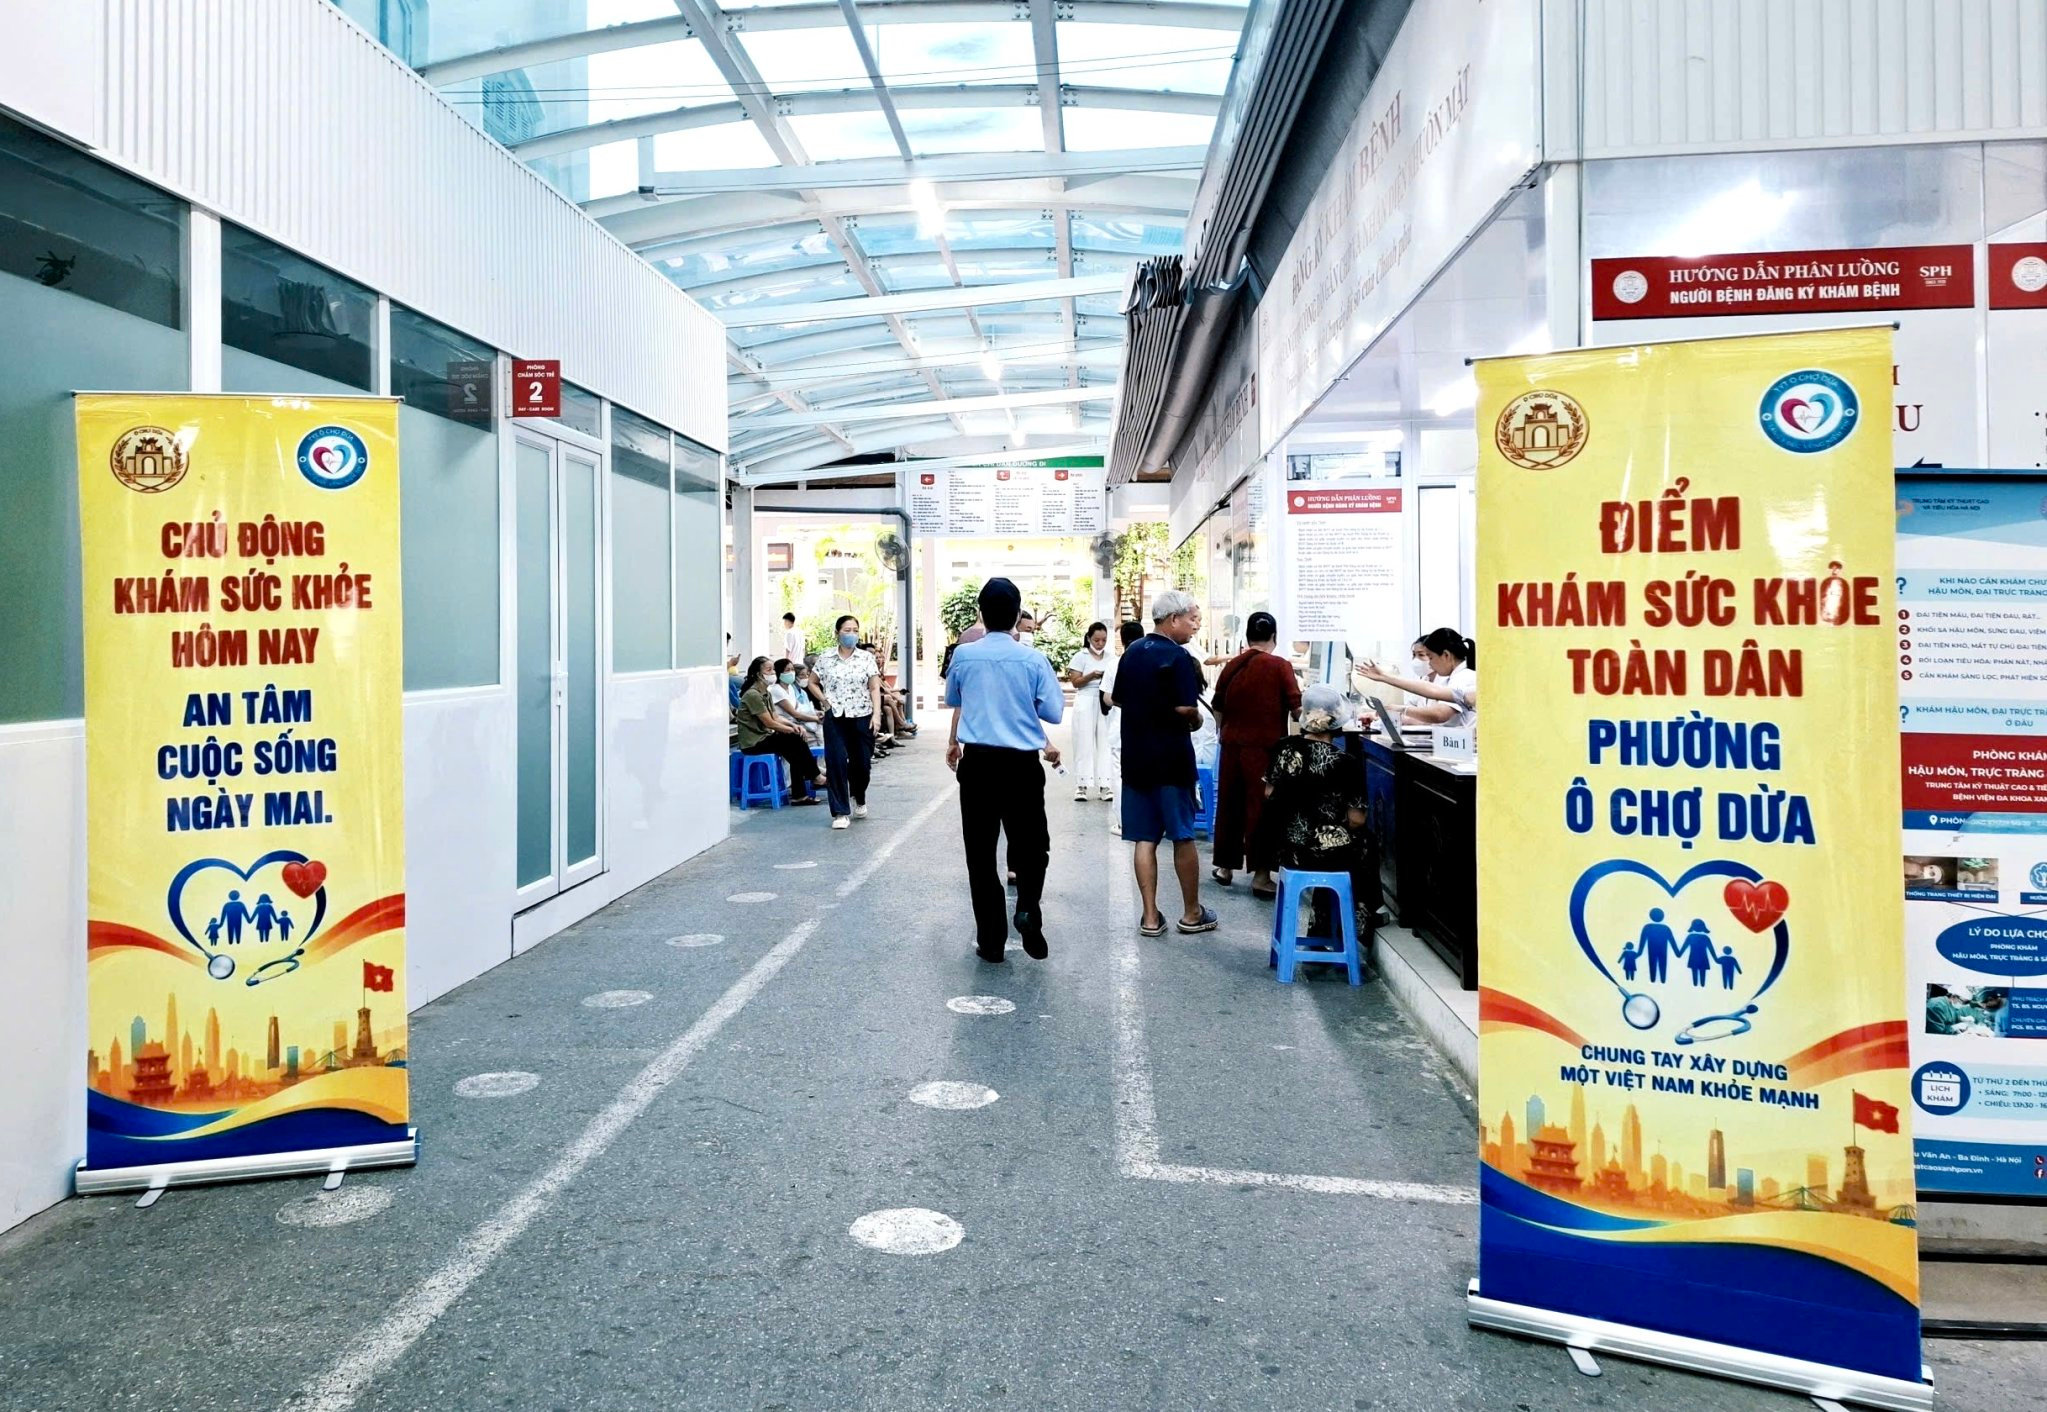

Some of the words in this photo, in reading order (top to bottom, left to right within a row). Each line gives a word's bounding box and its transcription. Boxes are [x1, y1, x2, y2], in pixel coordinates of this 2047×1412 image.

[1359, 89, 1402, 191] BỆNH
[1669, 265, 1739, 283] HƯỚNG
[1742, 260, 1780, 280] DẪN
[1784, 261, 1834, 279] PHÂN
[1838, 258, 1900, 277] LUỒNG
[1919, 265, 1952, 277] SPH
[1670, 287, 1712, 304] NGƯỜI
[1716, 286, 1752, 305] BỆNH
[1756, 285, 1794, 301] ĐĂNG
[1798, 283, 1815, 299] KÝ
[1819, 282, 1859, 299] KHÁM
[1863, 281, 1900, 300] BỆNH
[529, 381, 543, 401] 2
[1600, 477, 1741, 553] ĐIỂM
[161, 510, 227, 558] CHỦ
[237, 514, 325, 565] ĐỘNG
[114, 568, 209, 614] KHÁM
[220, 568, 281, 611] SỨC
[292, 562, 372, 610] KHỎE
[1950, 588, 1974, 596] MÔN,
[1958, 577, 1978, 585] NÀO
[2000, 577, 2026, 586] KHÁM
[1498, 572, 1626, 627] KHÁM
[1644, 570, 1737, 627] SỨC
[1753, 562, 1880, 626] KHỎE
[171, 623, 247, 668] HÔM
[258, 627, 319, 665] NAY
[1567, 640, 1687, 696] TOÀN
[1704, 639, 1803, 697] DÂN
[182, 693, 231, 727] AN
[242, 684, 312, 724] TÂM
[1945, 706, 1964, 714] HẬU
[1966, 706, 1990, 715] MÔN,
[2010, 708, 2032, 716] TRỰC
[2014, 718, 2034, 727] ĐÂU
[1443, 736, 1459, 748] Bàn
[1462, 738, 1466, 750] 1
[1588, 710, 1781, 771] PHƯỜNG
[157, 735, 243, 785] CUỘC
[254, 729, 337, 774] SỐNG
[1972, 749, 2016, 760] PHÒNG
[1908, 764, 1934, 778] HẬU
[1937, 765, 1968, 778] MÔN,
[1970, 766, 2002, 779] TRỰC
[2005, 766, 2044, 778] TRÀNG
[1952, 793, 1975, 802] BỆNH
[1976, 794, 1995, 802] VIỆN
[1972, 782, 1982, 790] KỸ
[1984, 782, 2009, 791] THUẬT
[166, 787, 253, 831] NGÀY
[264, 790, 333, 827] MAI.
[1565, 776, 1594, 834] Ô
[1610, 787, 1704, 849] CHỢ
[1718, 783, 1816, 845] DỪA
[1968, 927, 1982, 936] LÝ
[1984, 928, 2000, 936] DO
[2002, 928, 2025, 939] LỰA
[1581, 1045, 1646, 1066] CHUNG
[1651, 1051, 1683, 1069] TAY
[1690, 1051, 1726, 1073] XÂY
[1733, 1060, 1788, 1081] DỰNG
[1560, 1065, 1600, 1087] MỘT
[1605, 1068, 1645, 1092] VIỆT
[1652, 1078, 1695, 1095] NAM
[1701, 1078, 1753, 1102] KHỎE
[1759, 1088, 1819, 1110] MẠNH
[1930, 1085, 1950, 1093] LỊCH
[1986, 1077, 2004, 1085] THỨ
[2012, 1078, 2030, 1086] ĐẾN
[1926, 1094, 1954, 1103] KHÁM
[1921, 1151, 1938, 1159] Văn
[2008, 1156, 2022, 1164] Nội
